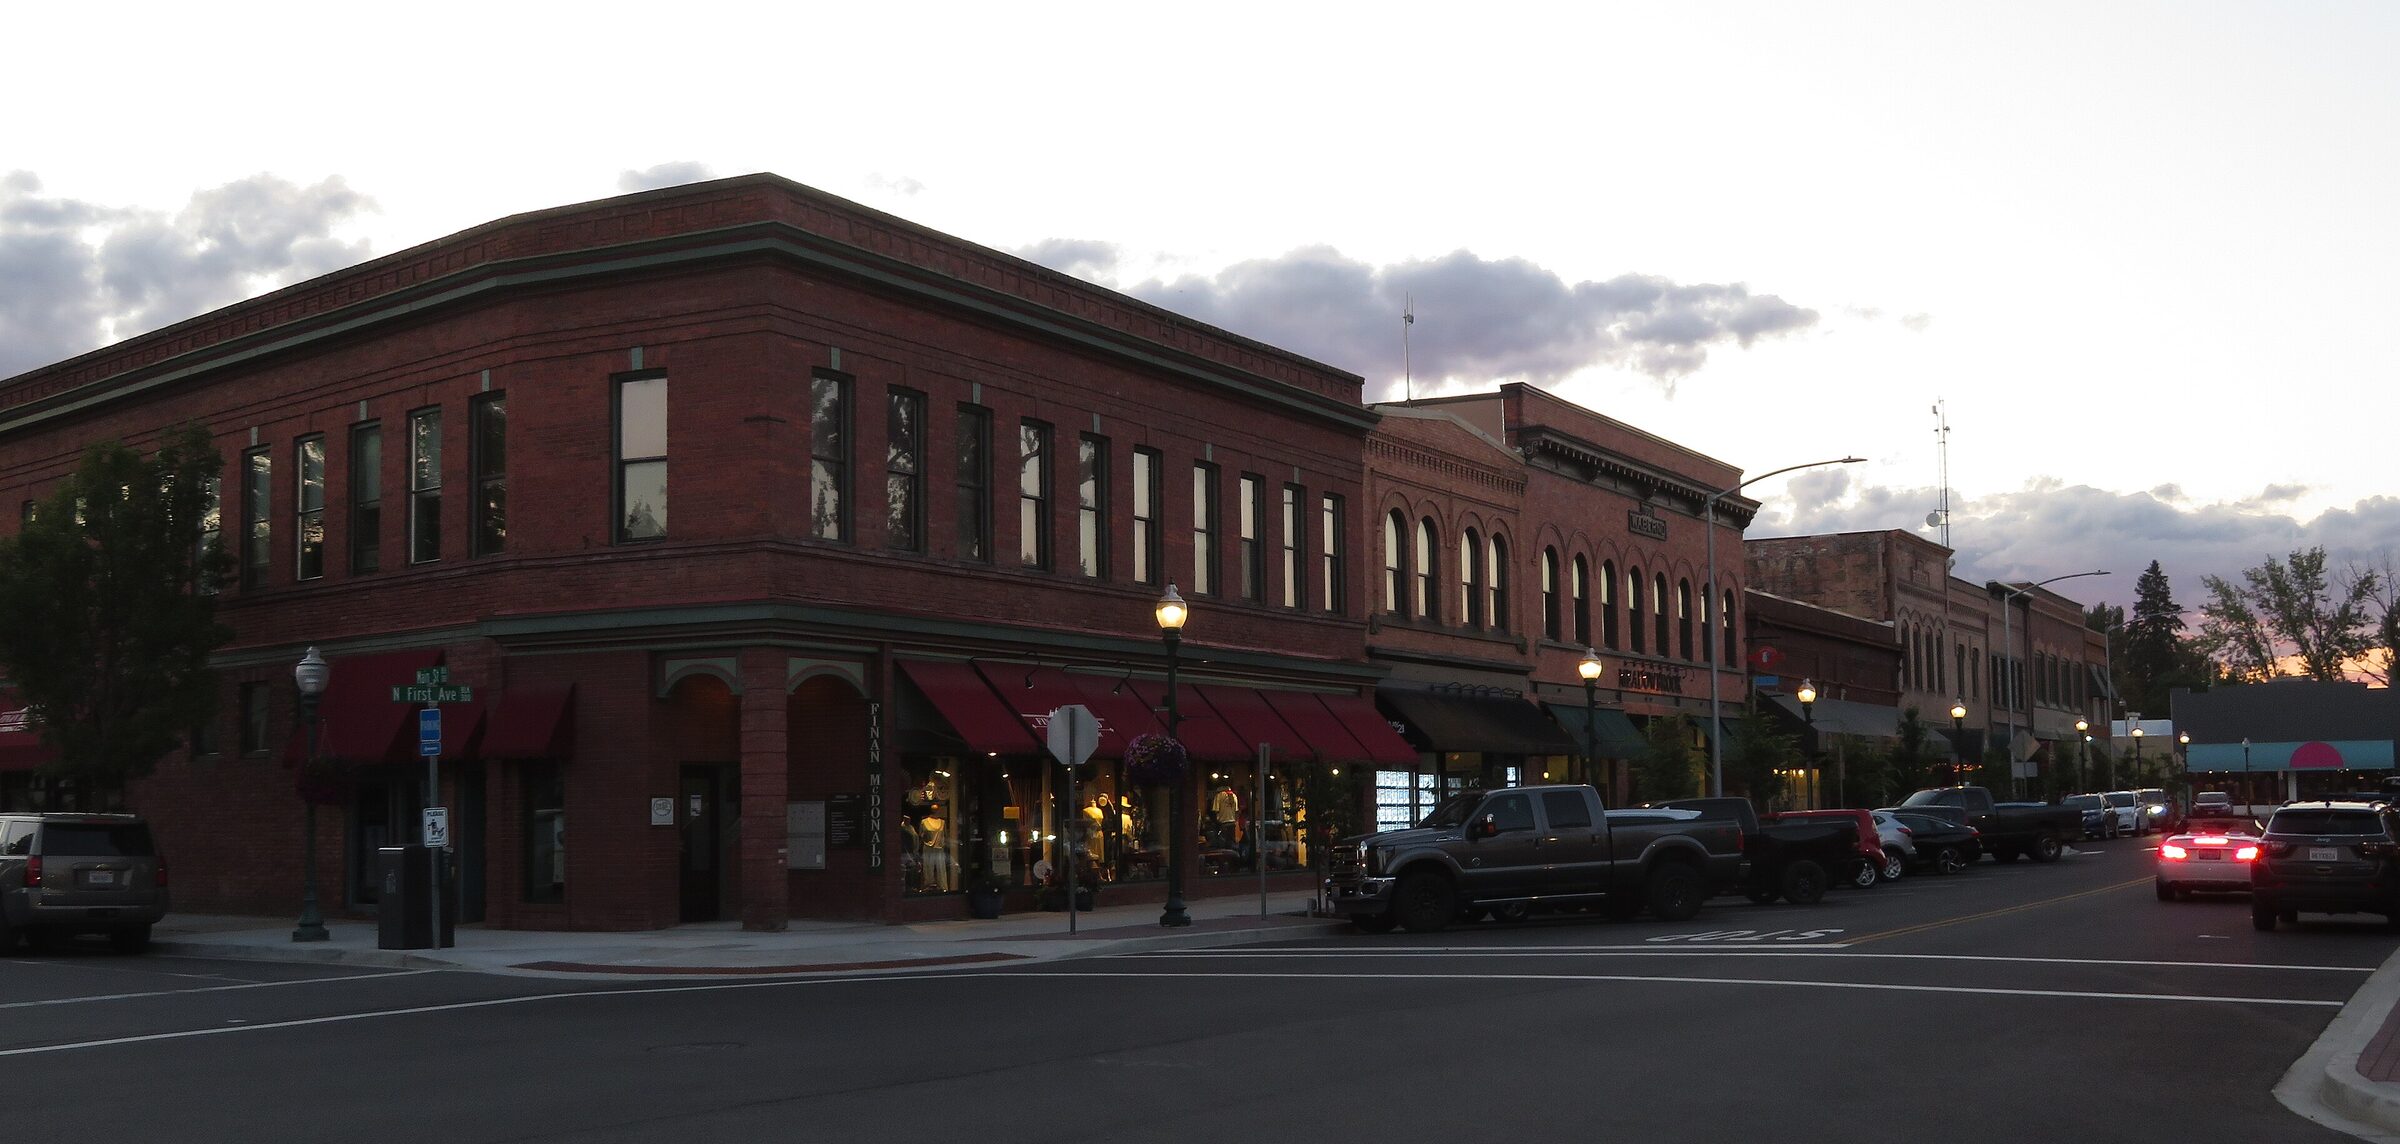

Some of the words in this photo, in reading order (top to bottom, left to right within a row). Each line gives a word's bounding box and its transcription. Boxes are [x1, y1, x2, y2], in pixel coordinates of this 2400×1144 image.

[416, 670, 430, 684] Main
[432, 668, 440, 683] St
[393, 687, 400, 701] N
[407, 687, 432, 701] First
[438, 687, 457, 701] Ave
[870, 703, 880, 763] FINAN
